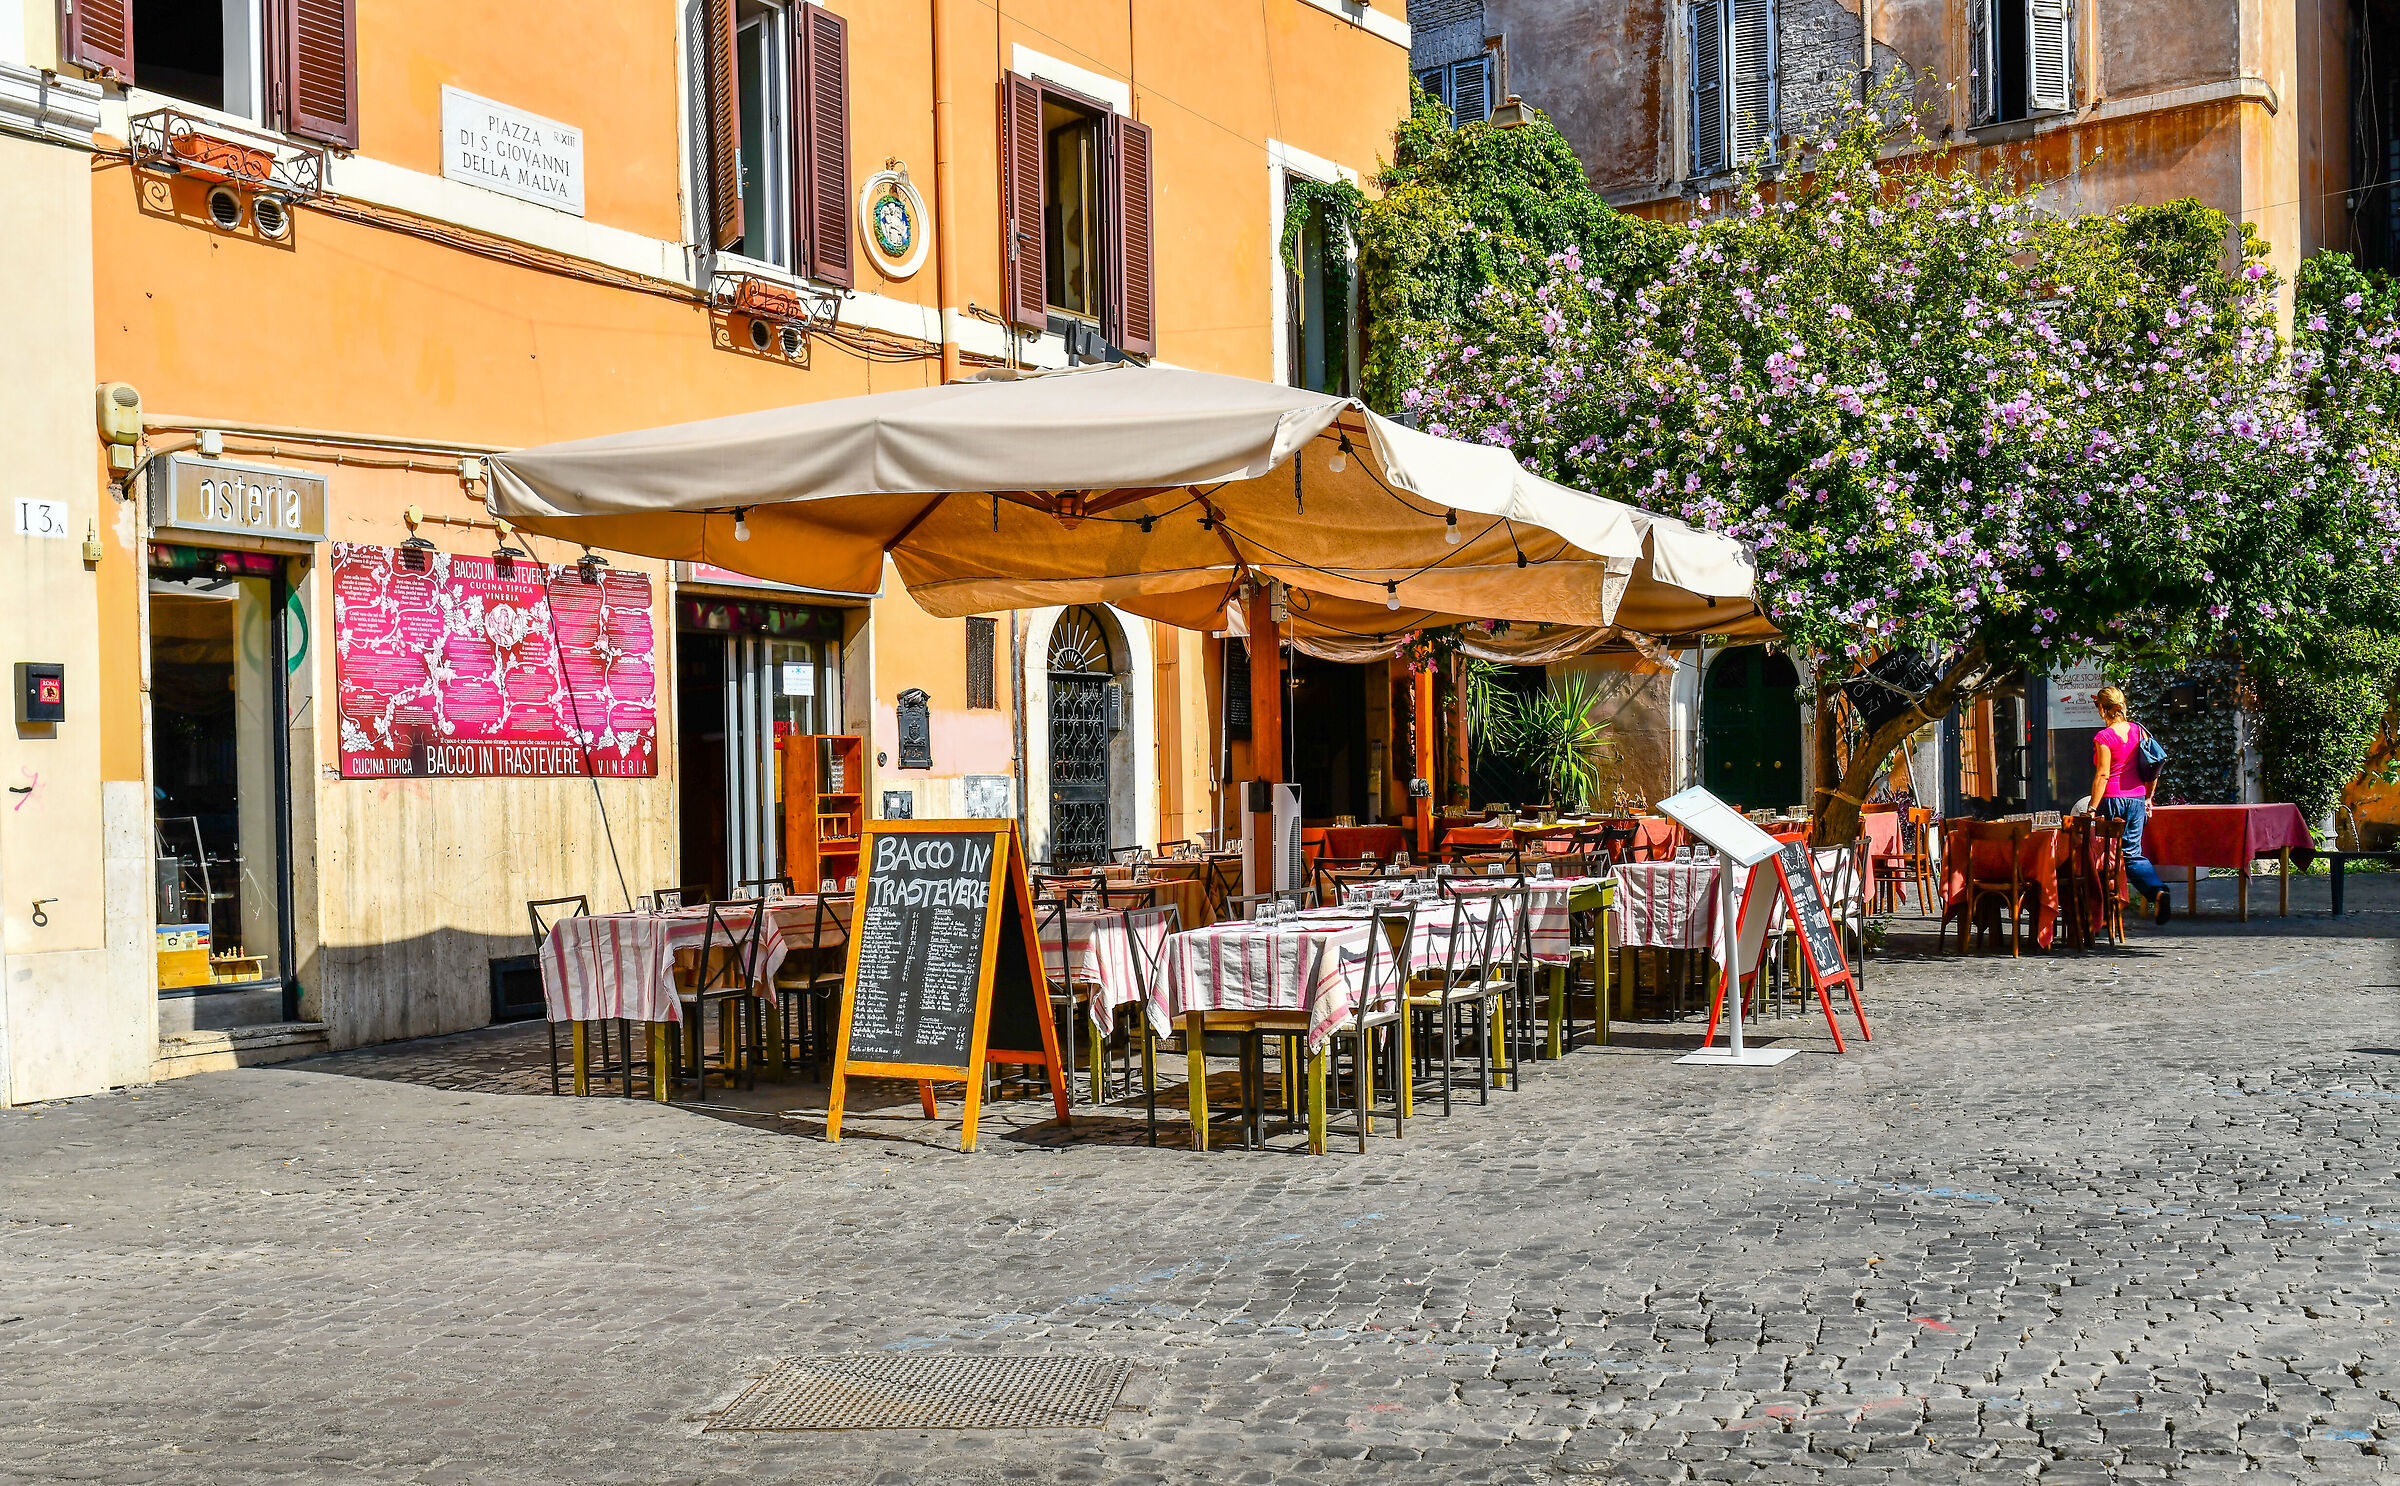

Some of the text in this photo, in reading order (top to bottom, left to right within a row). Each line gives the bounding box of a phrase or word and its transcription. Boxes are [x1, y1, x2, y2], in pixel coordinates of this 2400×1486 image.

[489, 116, 541, 146] PIAZZA
[460, 129, 570, 176] DI S. GIOVANNI
[463, 152, 568, 197] DELLA MALVA
[454, 560, 546, 586] BACCO IN TRASTEVERE
[470, 582, 533, 594] CUCINA TIPICA
[485, 592, 519, 602] VINERIA
[352, 745, 648, 775] CUCINA TIPICA BACCO IN TRASTEVERE VINERIA
[875, 836, 992, 874] BACCO IN
[868, 874, 991, 910] TRASTEVERE
